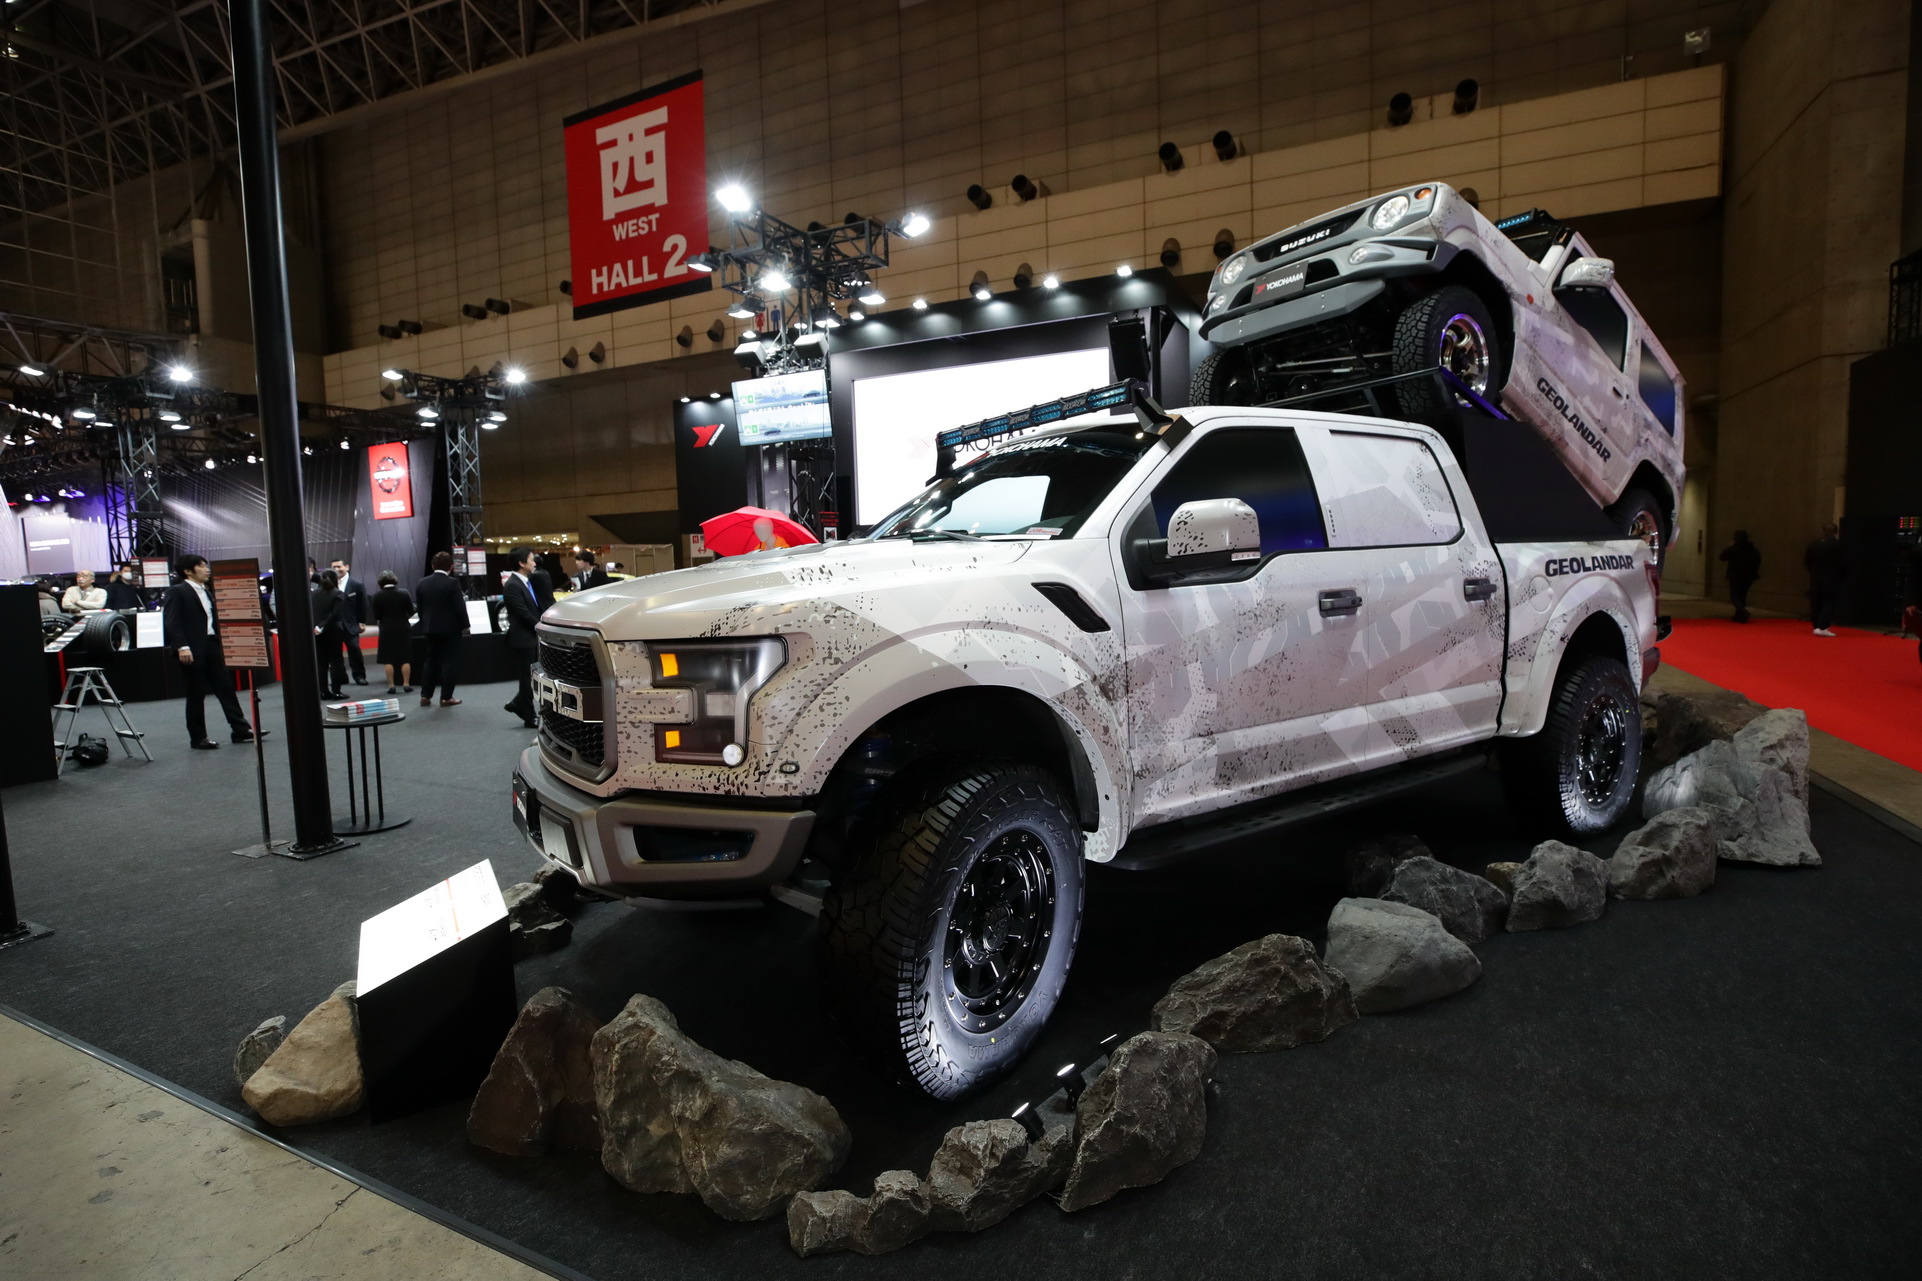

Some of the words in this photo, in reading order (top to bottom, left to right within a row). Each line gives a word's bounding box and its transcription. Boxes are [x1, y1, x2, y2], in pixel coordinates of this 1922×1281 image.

[596, 106, 669, 221] 西
[612, 213, 660, 241] WEST
[1280, 229, 1331, 252] SUZUKI
[591, 256, 658, 295] HALL
[662, 234, 688, 279] 2
[1266, 272, 1304, 291] YOKOHAMA
[1537, 377, 1612, 463] GEOLANDAR
[1545, 555, 1635, 577] GEOLANDAR
[531, 669, 584, 722] ORD
